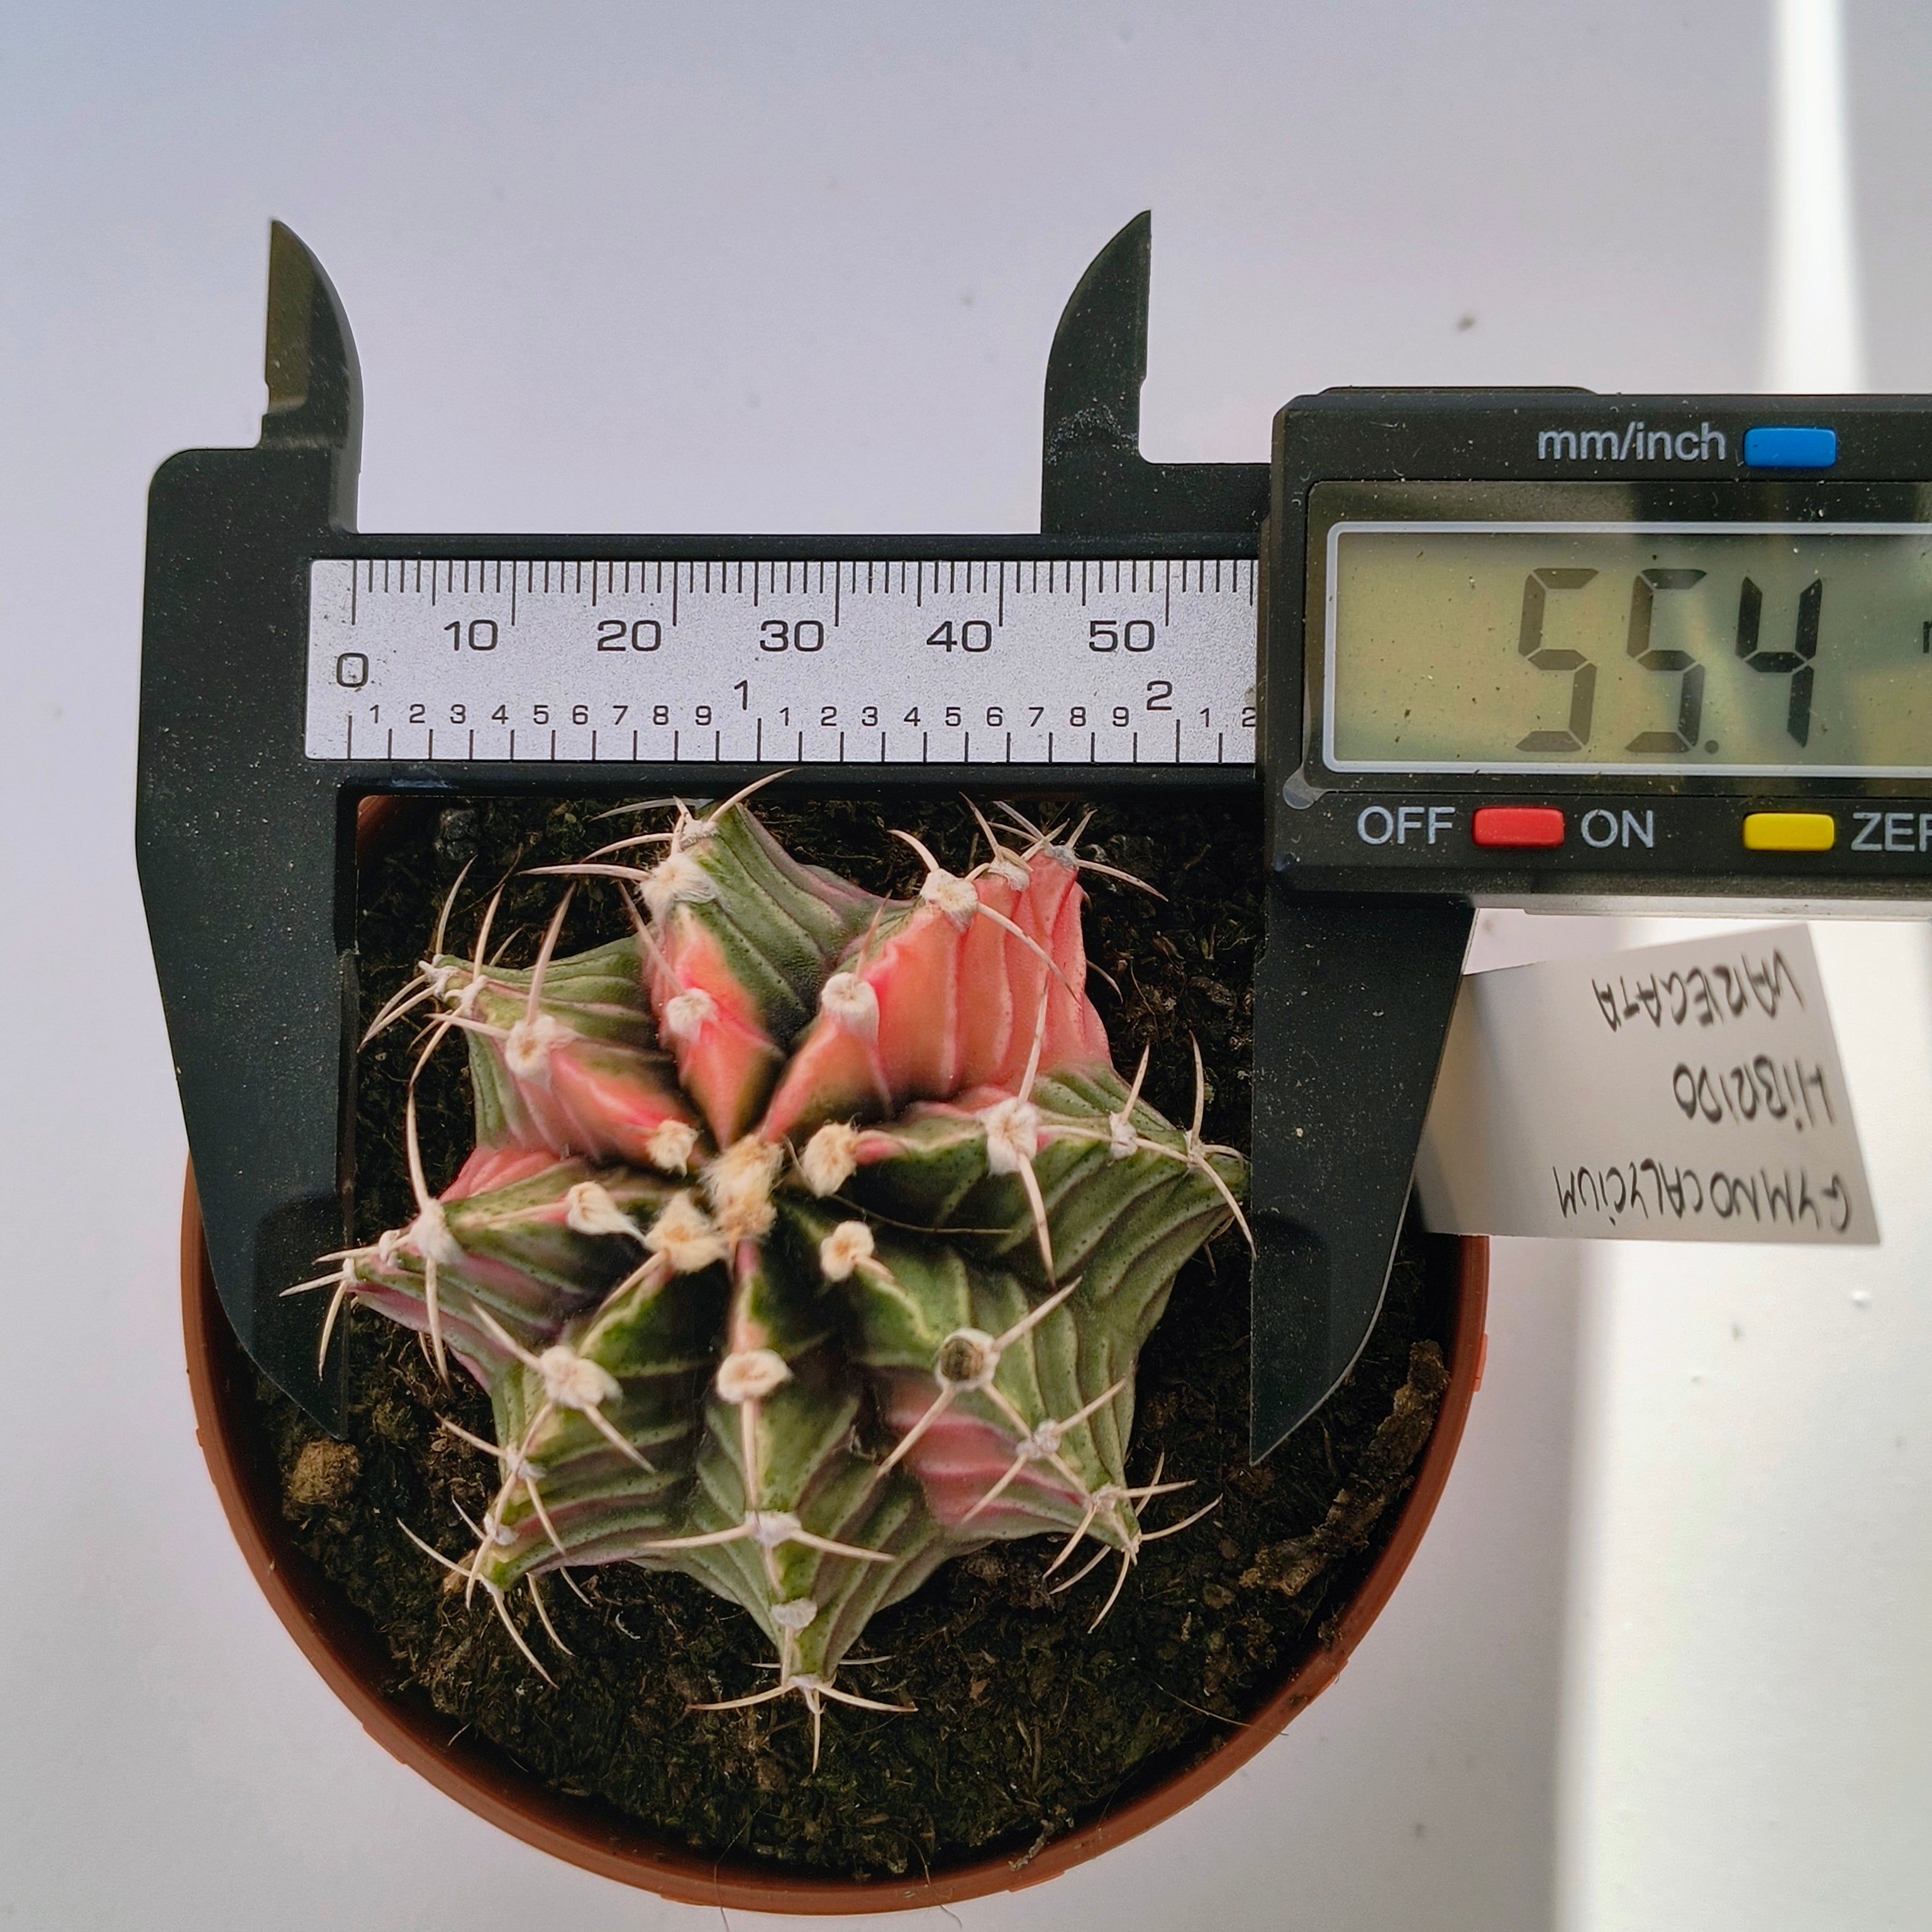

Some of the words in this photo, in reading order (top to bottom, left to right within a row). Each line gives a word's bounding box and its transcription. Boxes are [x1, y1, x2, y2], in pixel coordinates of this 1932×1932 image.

[1538, 421, 1727, 462] mm/inch
[444, 619, 498, 651] 10
[597, 620, 661, 652] 20
[760, 620, 824, 652] 30
[926, 621, 992, 652] 40
[1089, 620, 1155, 652] 50
[1515, 568, 1824, 753] 55.4
[336, 653, 369, 689] 0
[734, 680, 748, 710] 1
[1146, 680, 1172, 711] 2
[370, 704, 379, 723] 1
[409, 704, 425, 723] 2
[450, 704, 466, 724] 3
[492, 704, 509, 724] 4
[533, 705, 549, 724] 5
[572, 705, 588, 725] 6
[613, 705, 628, 725] 7
[653, 706, 669, 725] 8
[695, 706, 711, 726] 9
[780, 707, 789, 726] 1
[821, 706, 837, 726] 2
[862, 706, 878, 726] 3
[904, 707, 921, 726] 4
[945, 707, 961, 726] 5
[987, 707, 1003, 726] 6
[1028, 707, 1044, 727] 7
[1070, 707, 1086, 727] 8
[1113, 707, 1129, 727] 9
[1200, 708, 1209, 728] 1
[1357, 806, 1457, 845] OFF
[1581, 809, 1655, 848] ON
